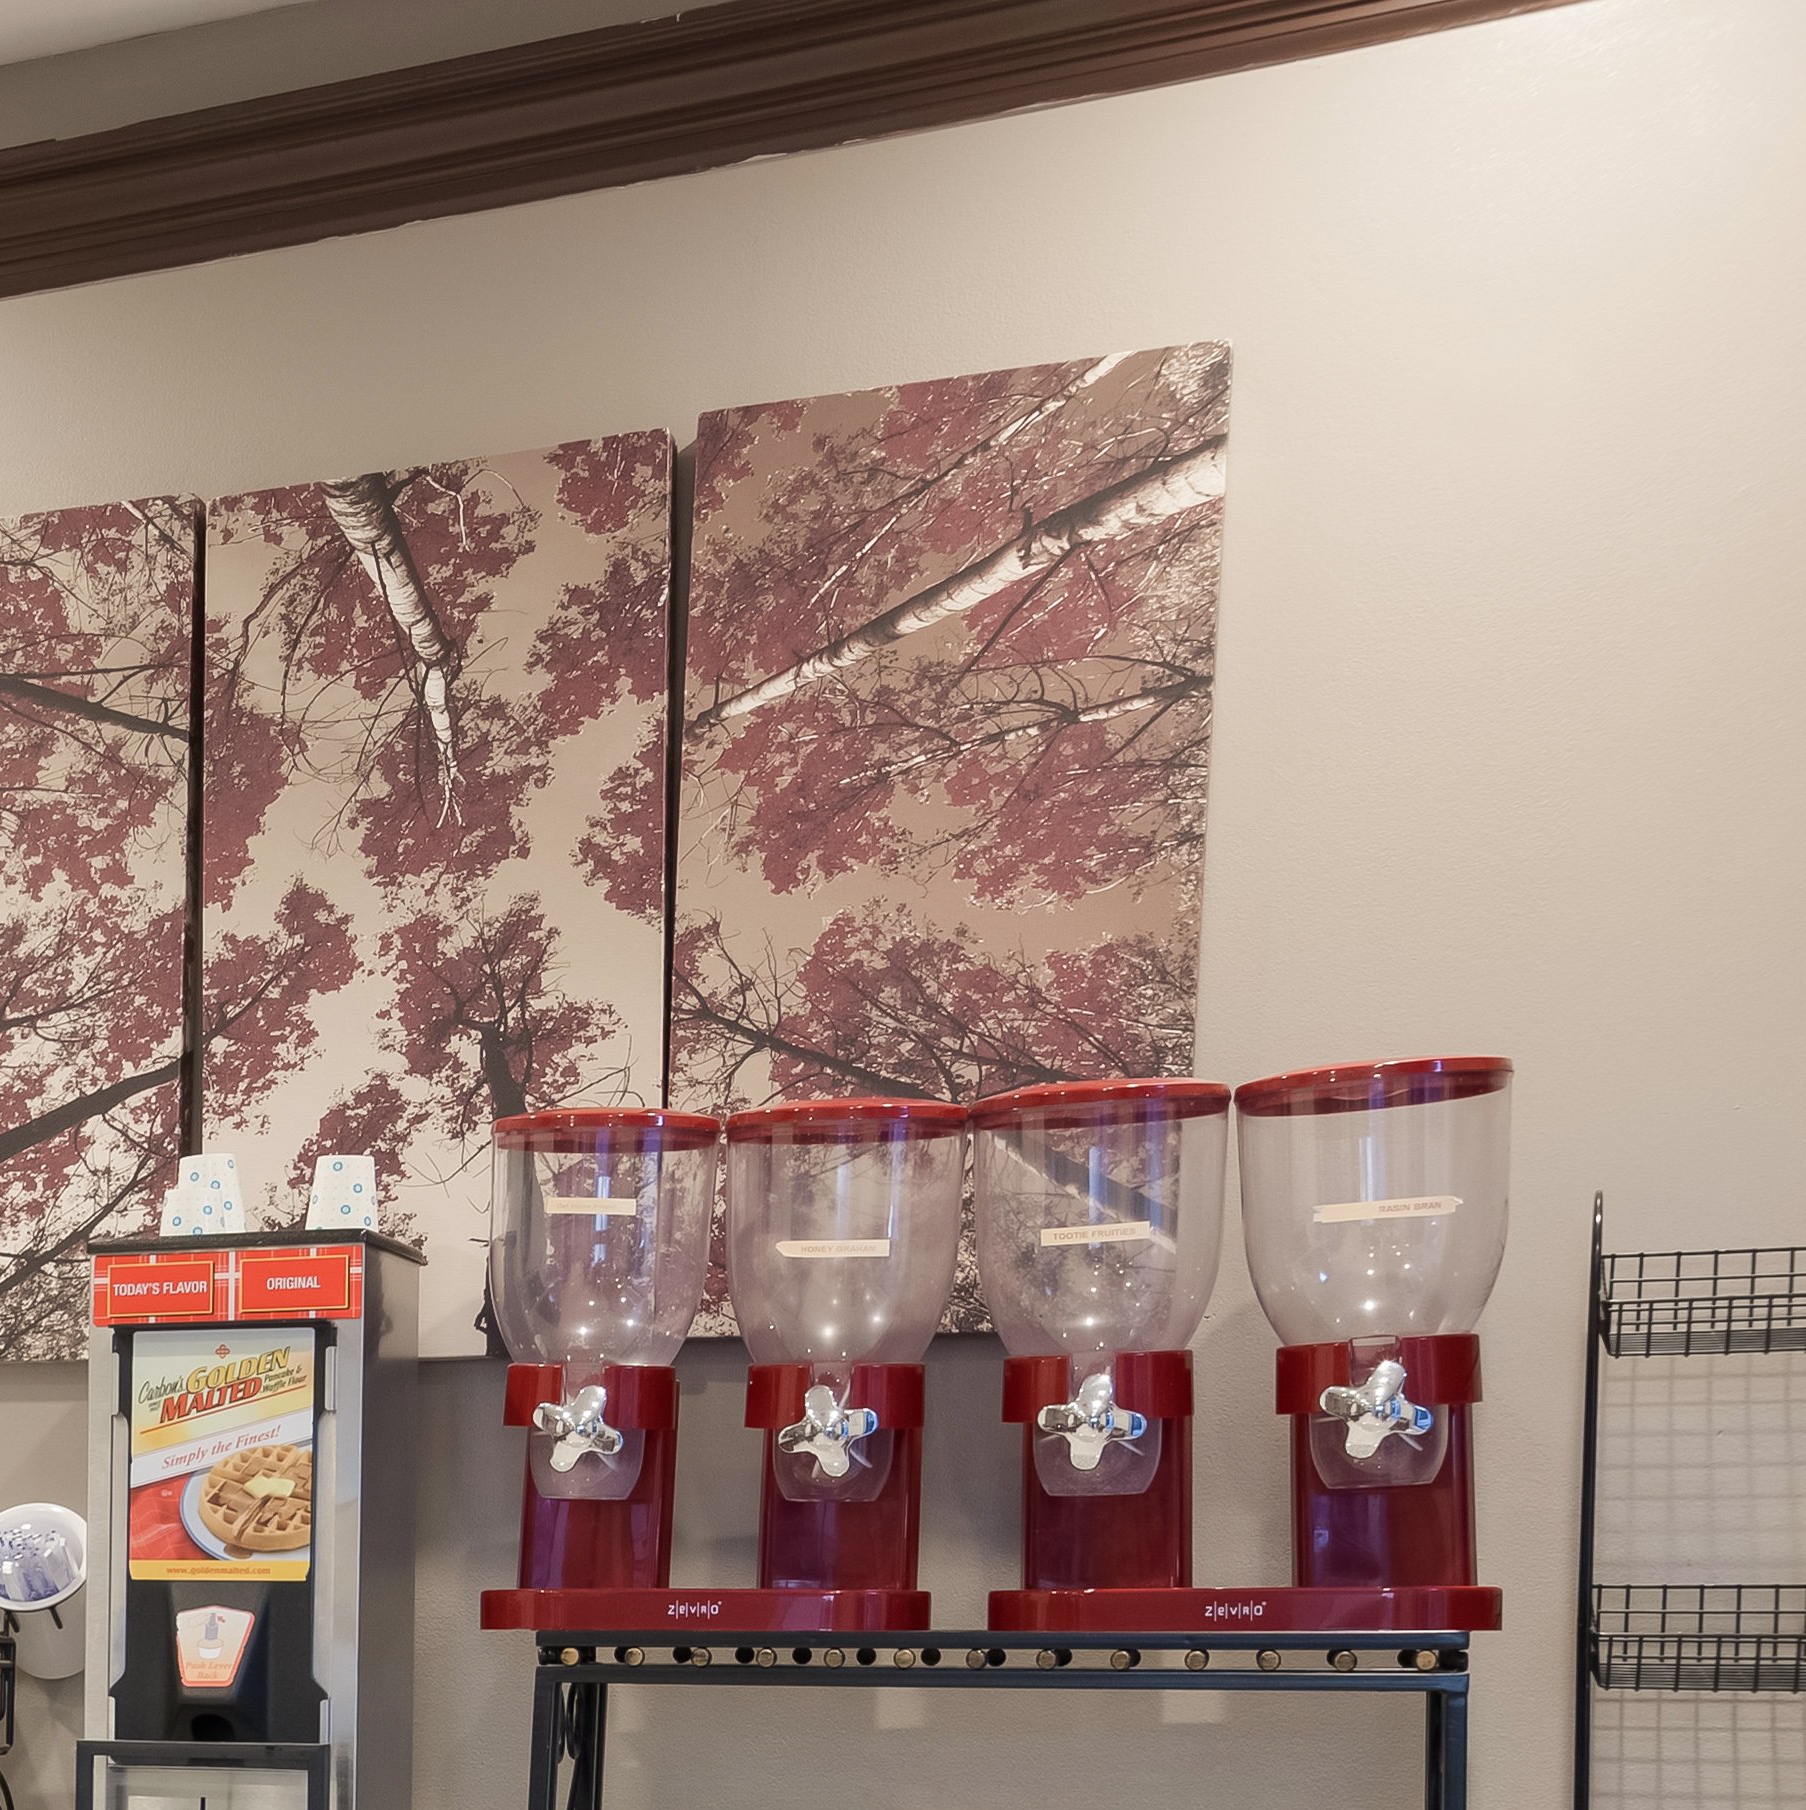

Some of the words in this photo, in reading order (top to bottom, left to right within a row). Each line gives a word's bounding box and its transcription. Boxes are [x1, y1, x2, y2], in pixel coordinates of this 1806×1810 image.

[1379, 1204, 1410, 1213] RASIN
[1414, 1202, 1442, 1211] BRAN
[1053, 1231, 1087, 1240] TOOTIE
[112, 1282, 160, 1296] TODAY'S
[163, 1280, 207, 1294] FLAVOR
[266, 1276, 321, 1290] ORIGINAL
[138, 1375, 184, 1404] Carbon's
[186, 1346, 290, 1394] GOLDEN
[159, 1377, 262, 1423] MALTED
[161, 1447, 208, 1469] Simply
[211, 1440, 233, 1455] the
[235, 1425, 282, 1448] Finest!
[166, 1566, 271, 1575] www.goldenmalted.com
